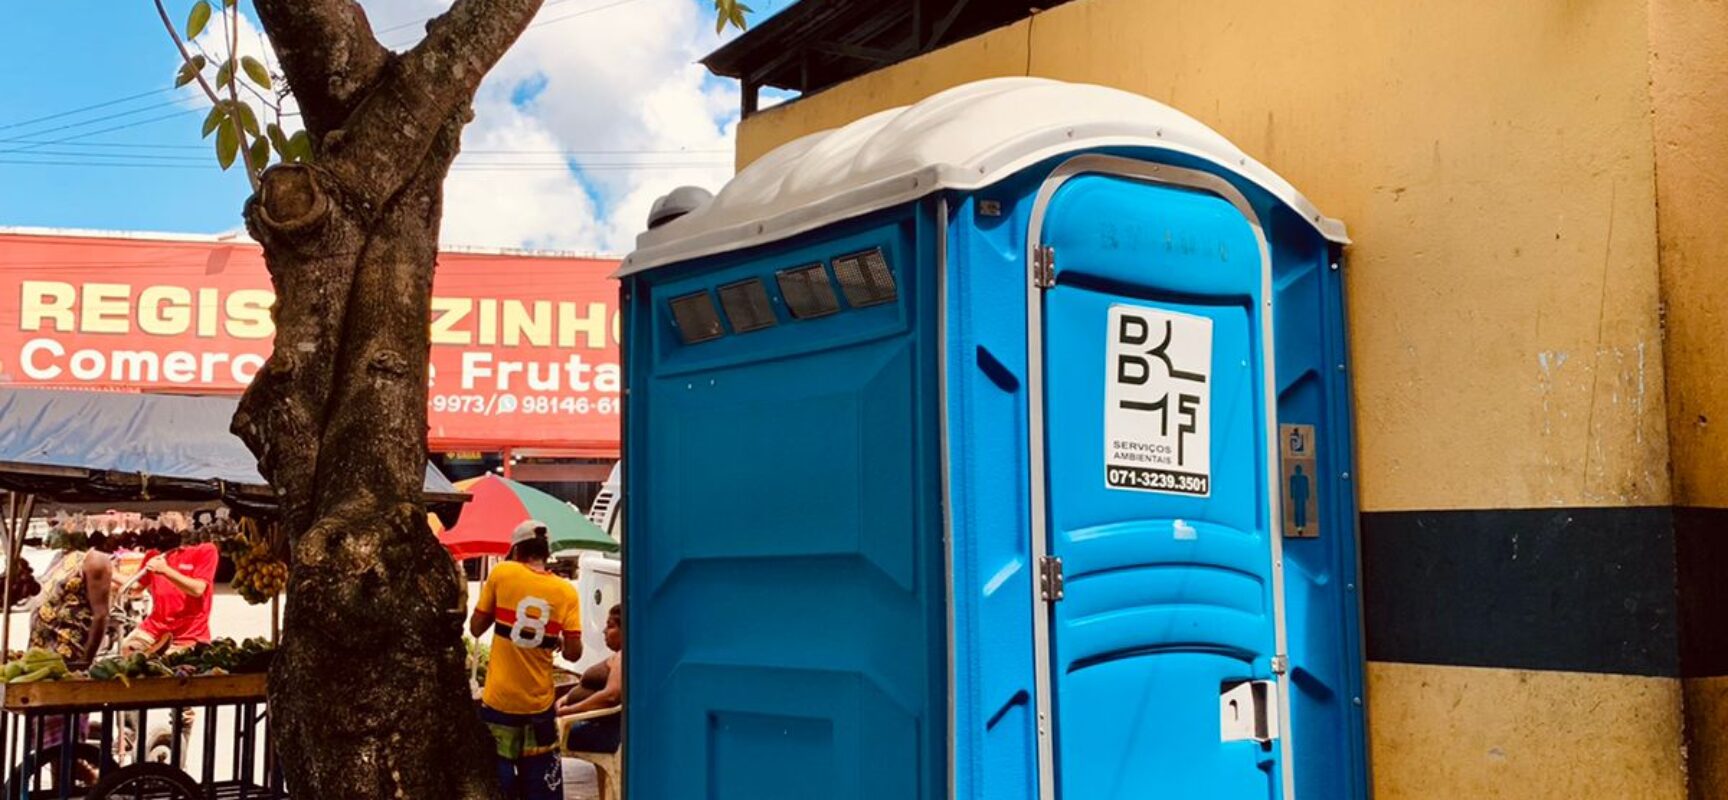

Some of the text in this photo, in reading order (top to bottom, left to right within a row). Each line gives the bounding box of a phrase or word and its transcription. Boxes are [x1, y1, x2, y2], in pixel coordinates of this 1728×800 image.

[430, 297, 620, 348] ZINH
[1113, 440, 1172, 454] SERVIÇOS
[1113, 451, 1172, 465] AMBIENTAIS
[1109, 469, 1207, 493] 071-3239.3501
[510, 596, 550, 649] 8
